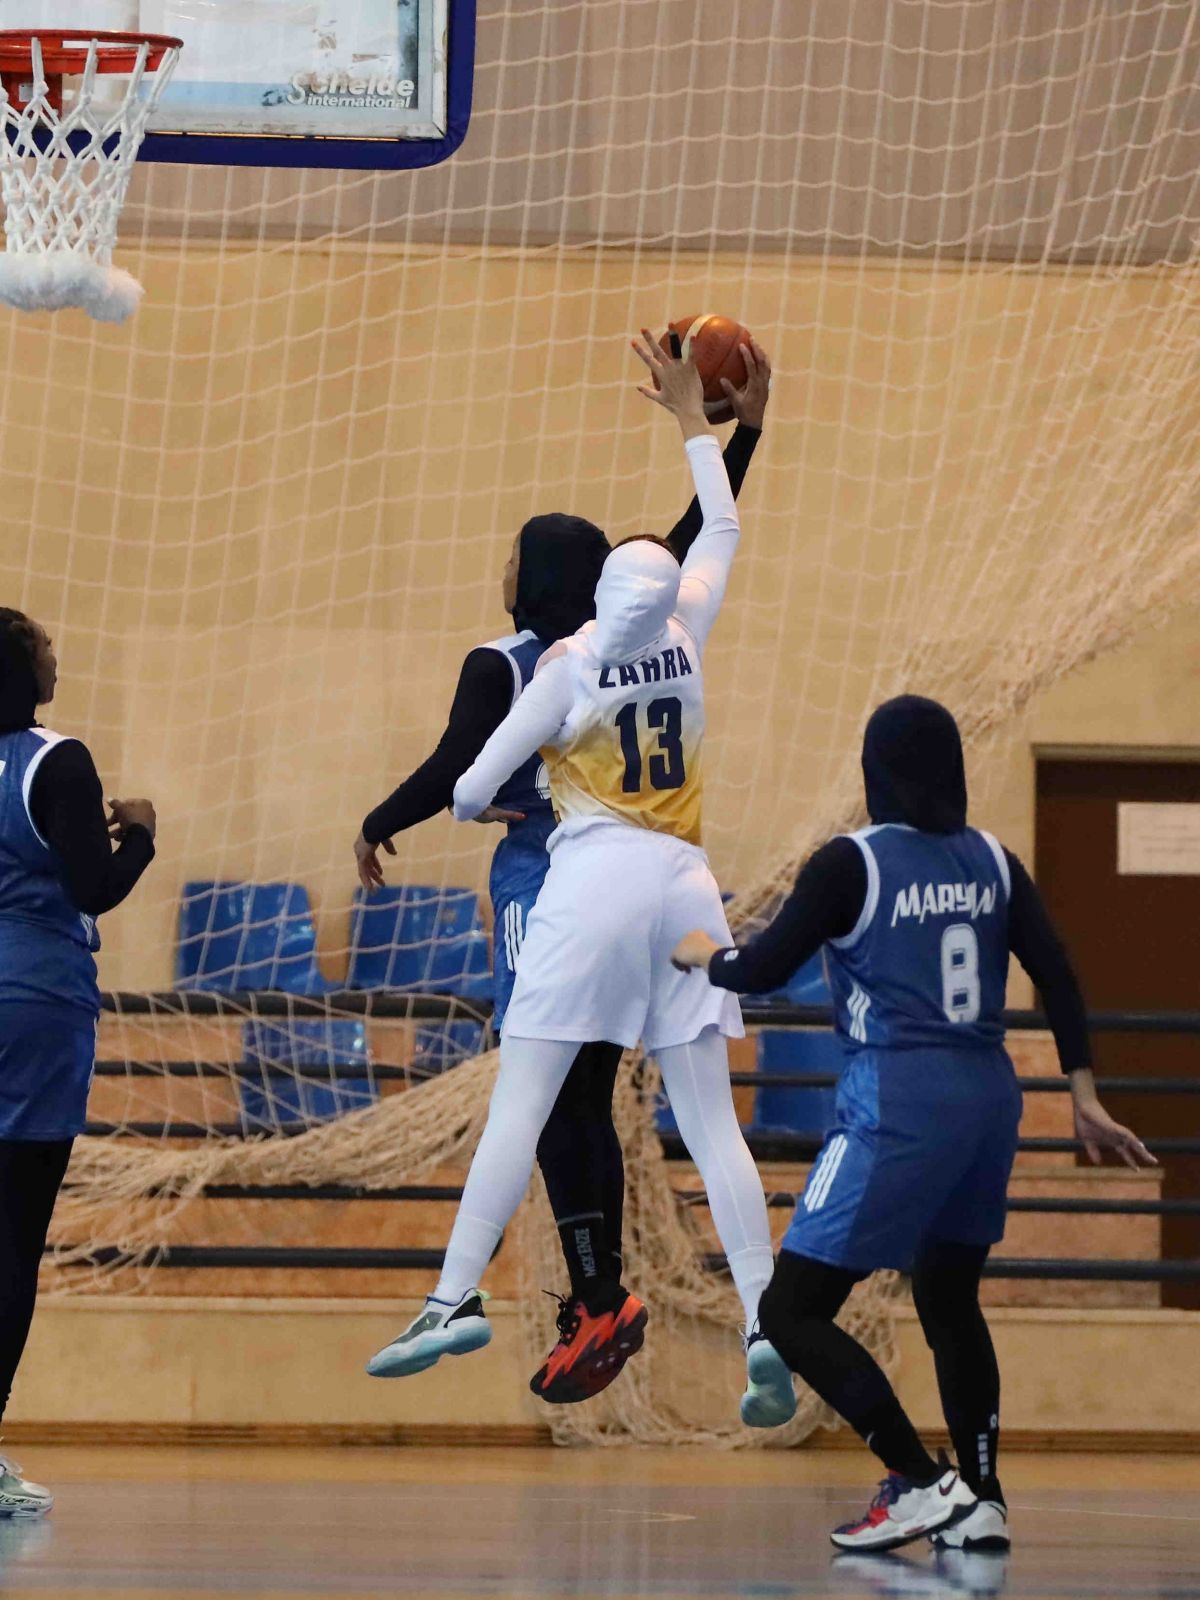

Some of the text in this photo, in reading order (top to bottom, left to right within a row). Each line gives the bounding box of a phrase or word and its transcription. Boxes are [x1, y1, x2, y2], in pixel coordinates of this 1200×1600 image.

[598, 646, 693, 689] ZAHRA
[614, 696, 687, 793] 13
[940, 922, 982, 1024] 8
